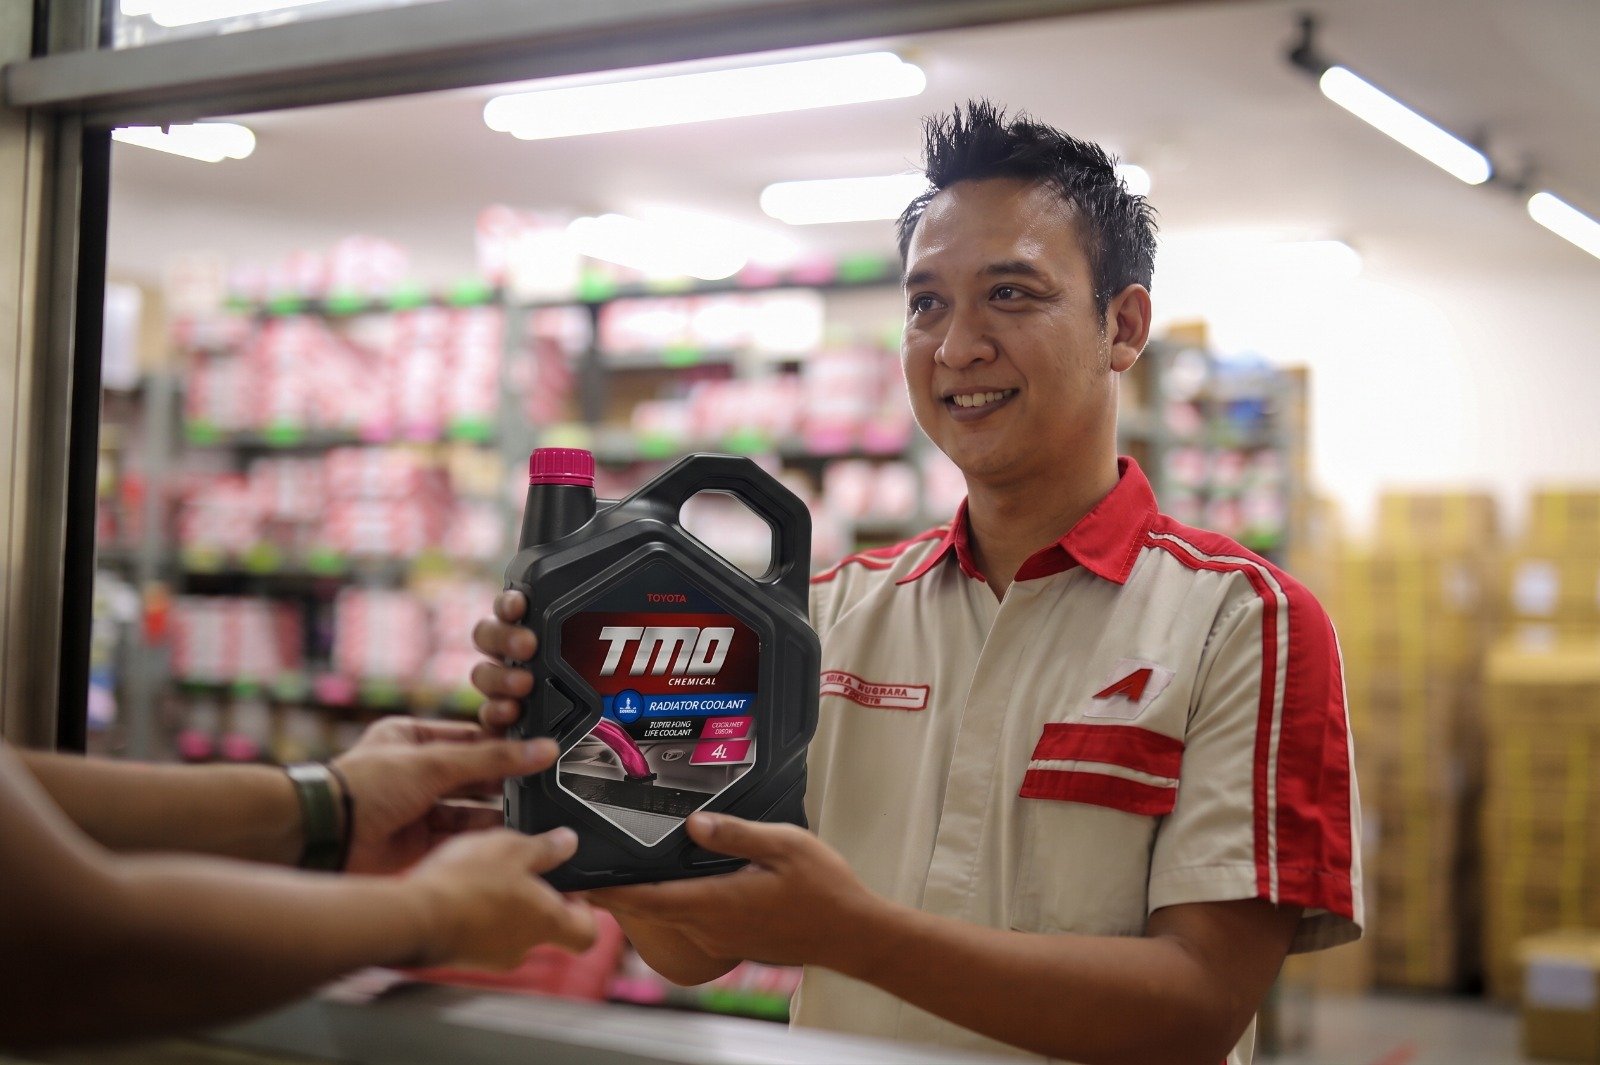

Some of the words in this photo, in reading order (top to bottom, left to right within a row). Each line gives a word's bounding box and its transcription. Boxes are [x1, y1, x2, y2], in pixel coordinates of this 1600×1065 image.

[647, 593, 687, 603] TOYOTA
[599, 626, 735, 677] TMO
[668, 677, 717, 686] CHEMICAL
[649, 701, 700, 711] RADIATOR
[700, 699, 747, 710] COOLANT
[659, 728, 692, 737] COOLANT
[711, 743, 728, 759] 4L
